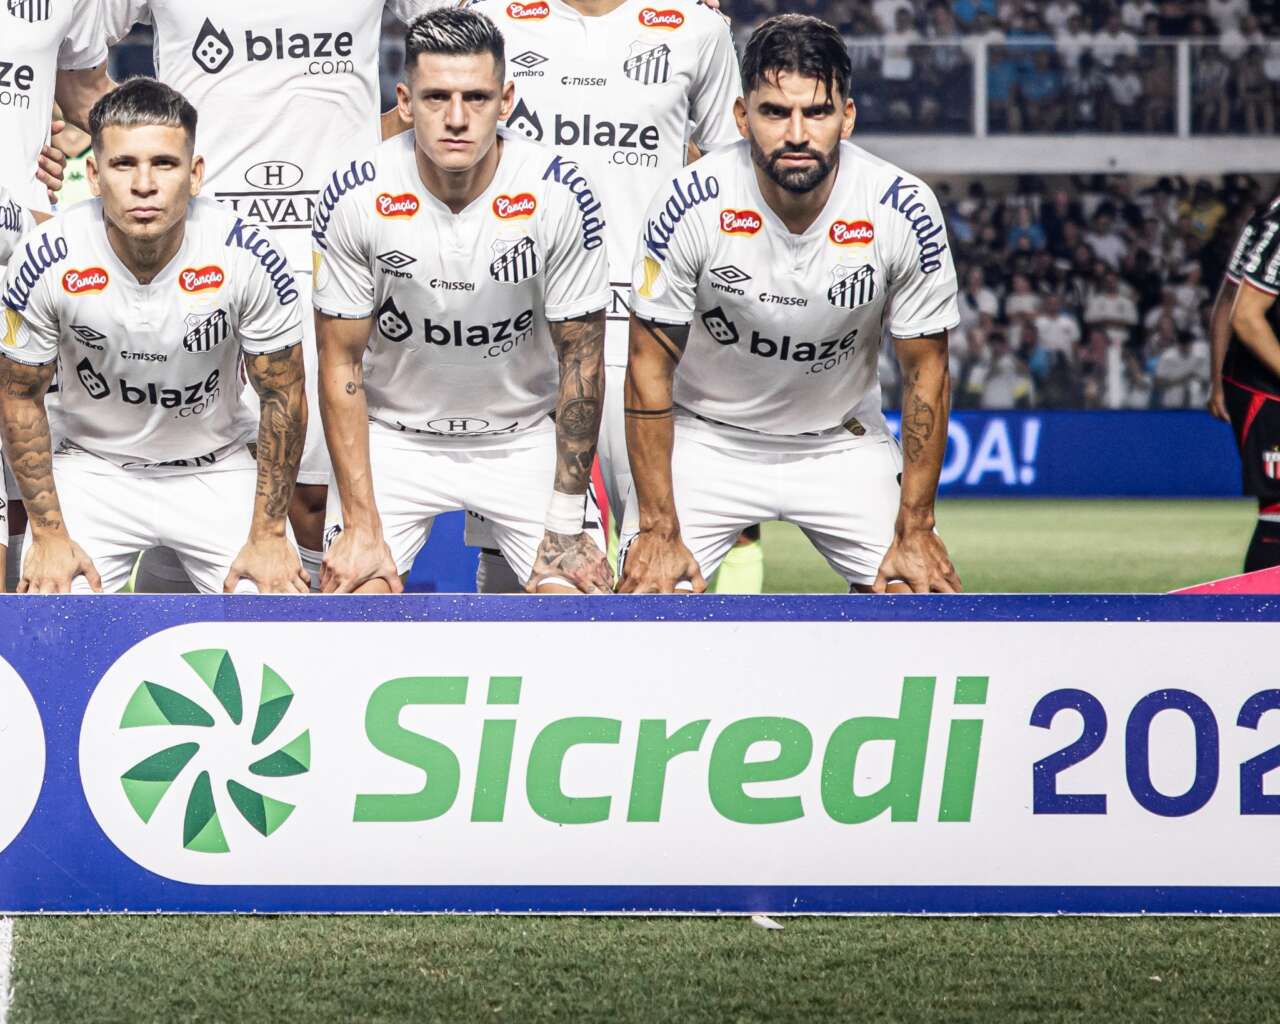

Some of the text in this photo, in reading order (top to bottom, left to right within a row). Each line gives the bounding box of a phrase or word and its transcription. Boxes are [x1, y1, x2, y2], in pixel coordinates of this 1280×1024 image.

[245, 29, 353, 61] blaze
[303, 60, 354, 76] .com
[512, 69, 544, 77] umbro
[554, 114, 660, 150] blaze
[264, 165, 285, 185] H
[608, 150, 658, 168] .com
[542, 155, 606, 251] Kicaldo
[644, 170, 720, 261] Kicaldo
[880, 176, 950, 275] Kicaldo
[1, 232, 68, 312] Kicaldo
[225, 218, 299, 307] Kicaldo
[381, 267, 413, 279] umbro
[711, 283, 744, 296] umbro
[424, 308, 533, 347] blaze
[483, 327, 533, 359] .com
[750, 329, 858, 362] blaze
[805, 345, 855, 375] .com
[120, 368, 220, 408] blaze
[174, 387, 220, 419] .com
[448, 420, 467, 431] H
[353, 675, 990, 824] Sicredi
